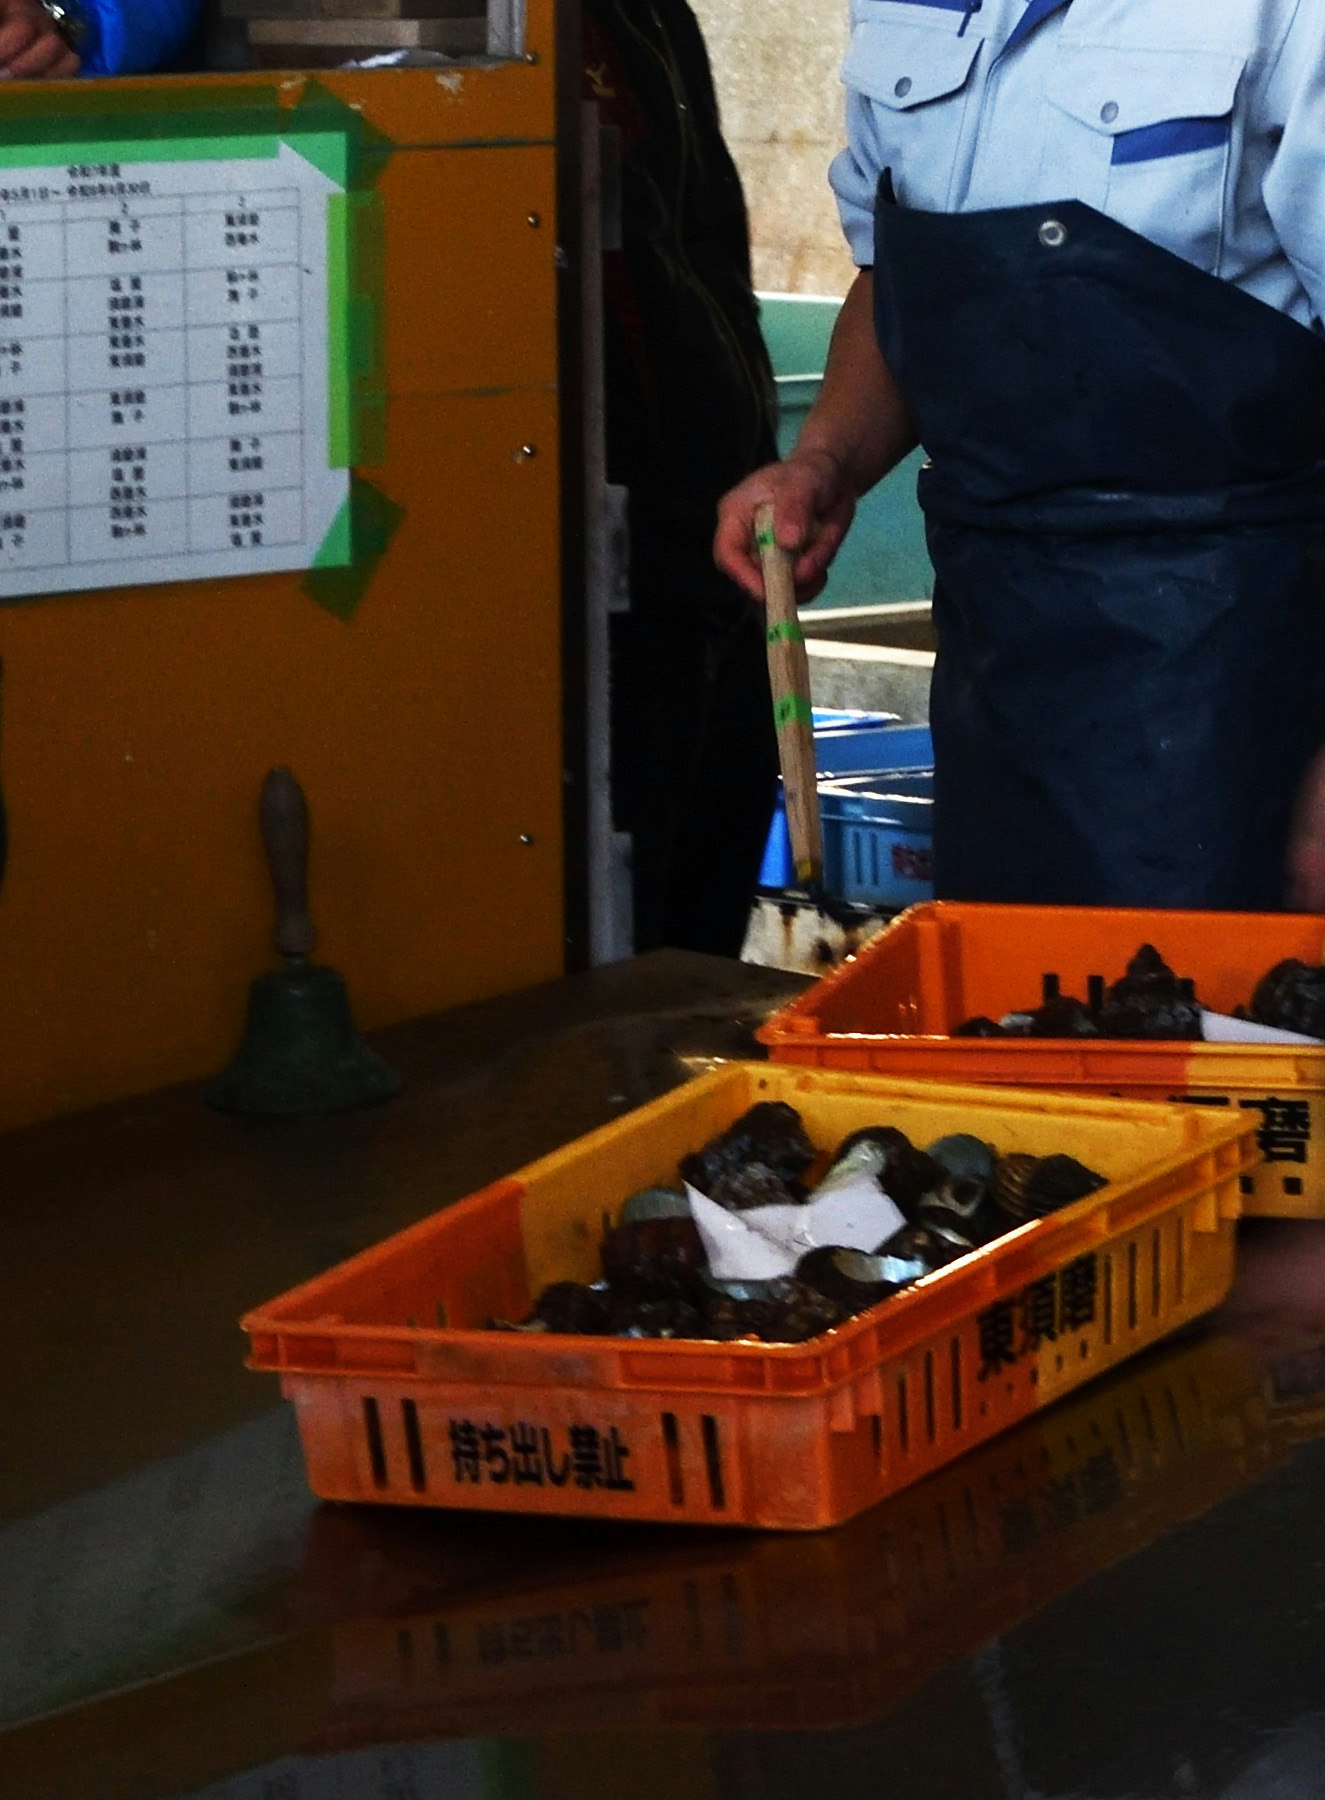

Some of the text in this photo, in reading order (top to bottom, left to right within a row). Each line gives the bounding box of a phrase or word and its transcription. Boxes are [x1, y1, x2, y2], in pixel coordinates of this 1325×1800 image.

[976, 1252, 1097, 1383] 東須磨
[449, 1419, 637, 1491] 持ち出し禁止
